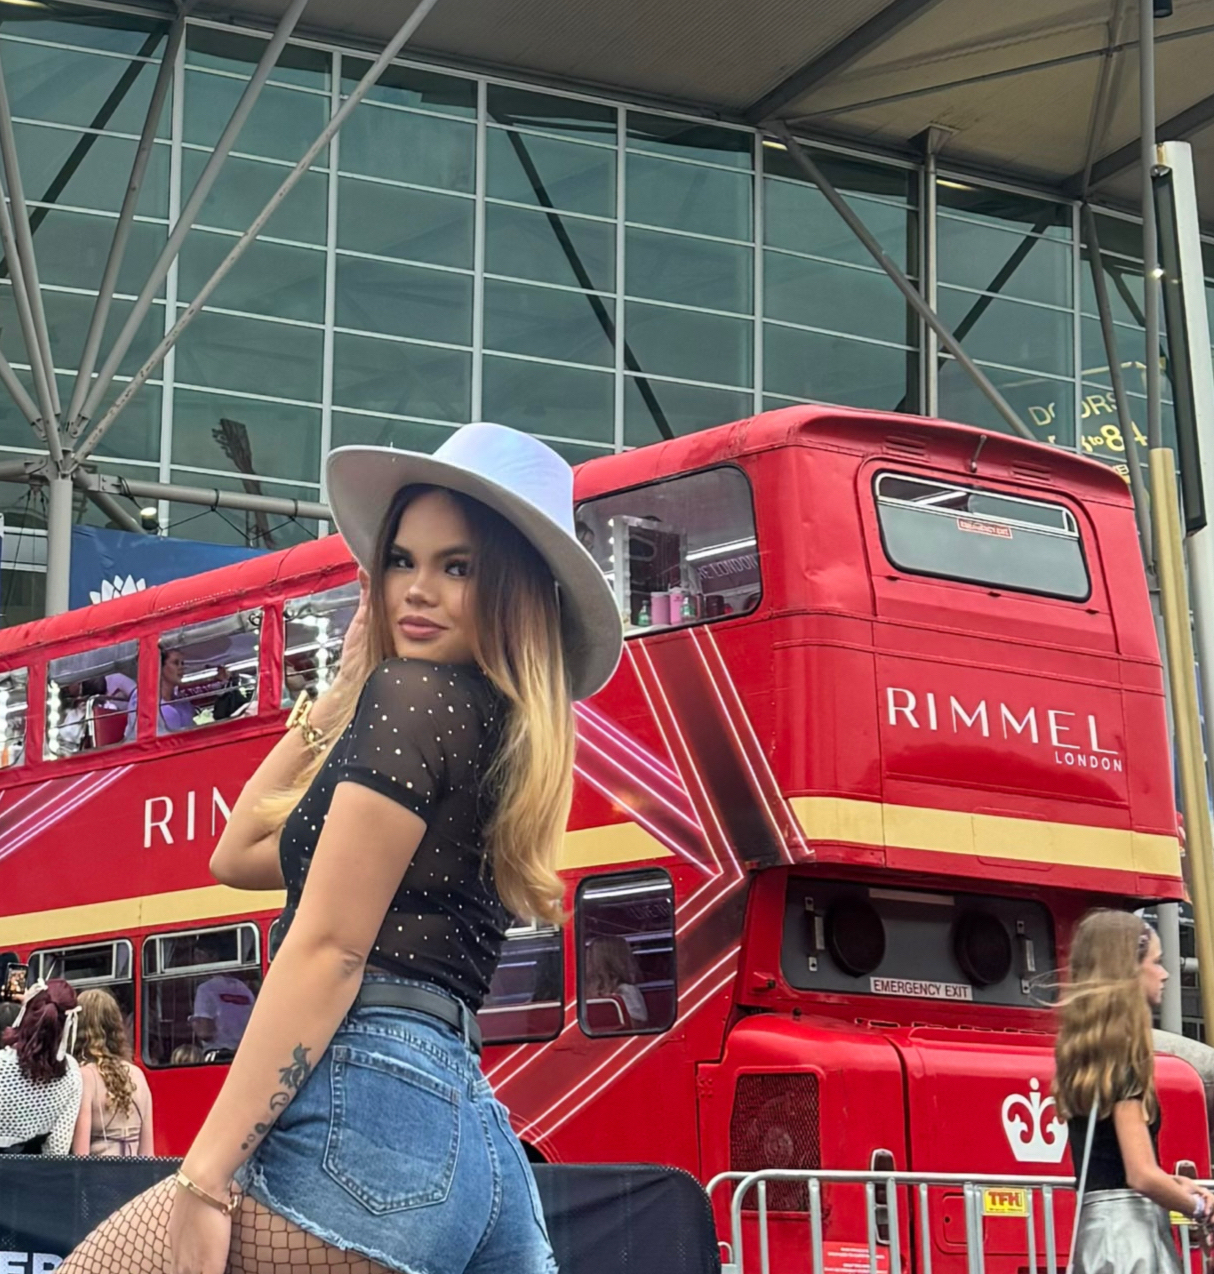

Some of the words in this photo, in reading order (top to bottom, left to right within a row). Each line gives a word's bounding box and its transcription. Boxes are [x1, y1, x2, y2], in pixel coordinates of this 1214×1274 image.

[886, 687, 1119, 755] RIMMEL
[1055, 751, 1123, 772] LONDON
[874, 979, 943, 997] EMERGENCY
[945, 983, 968, 998] EXIT
[988, 1191, 1023, 1207] TFH
